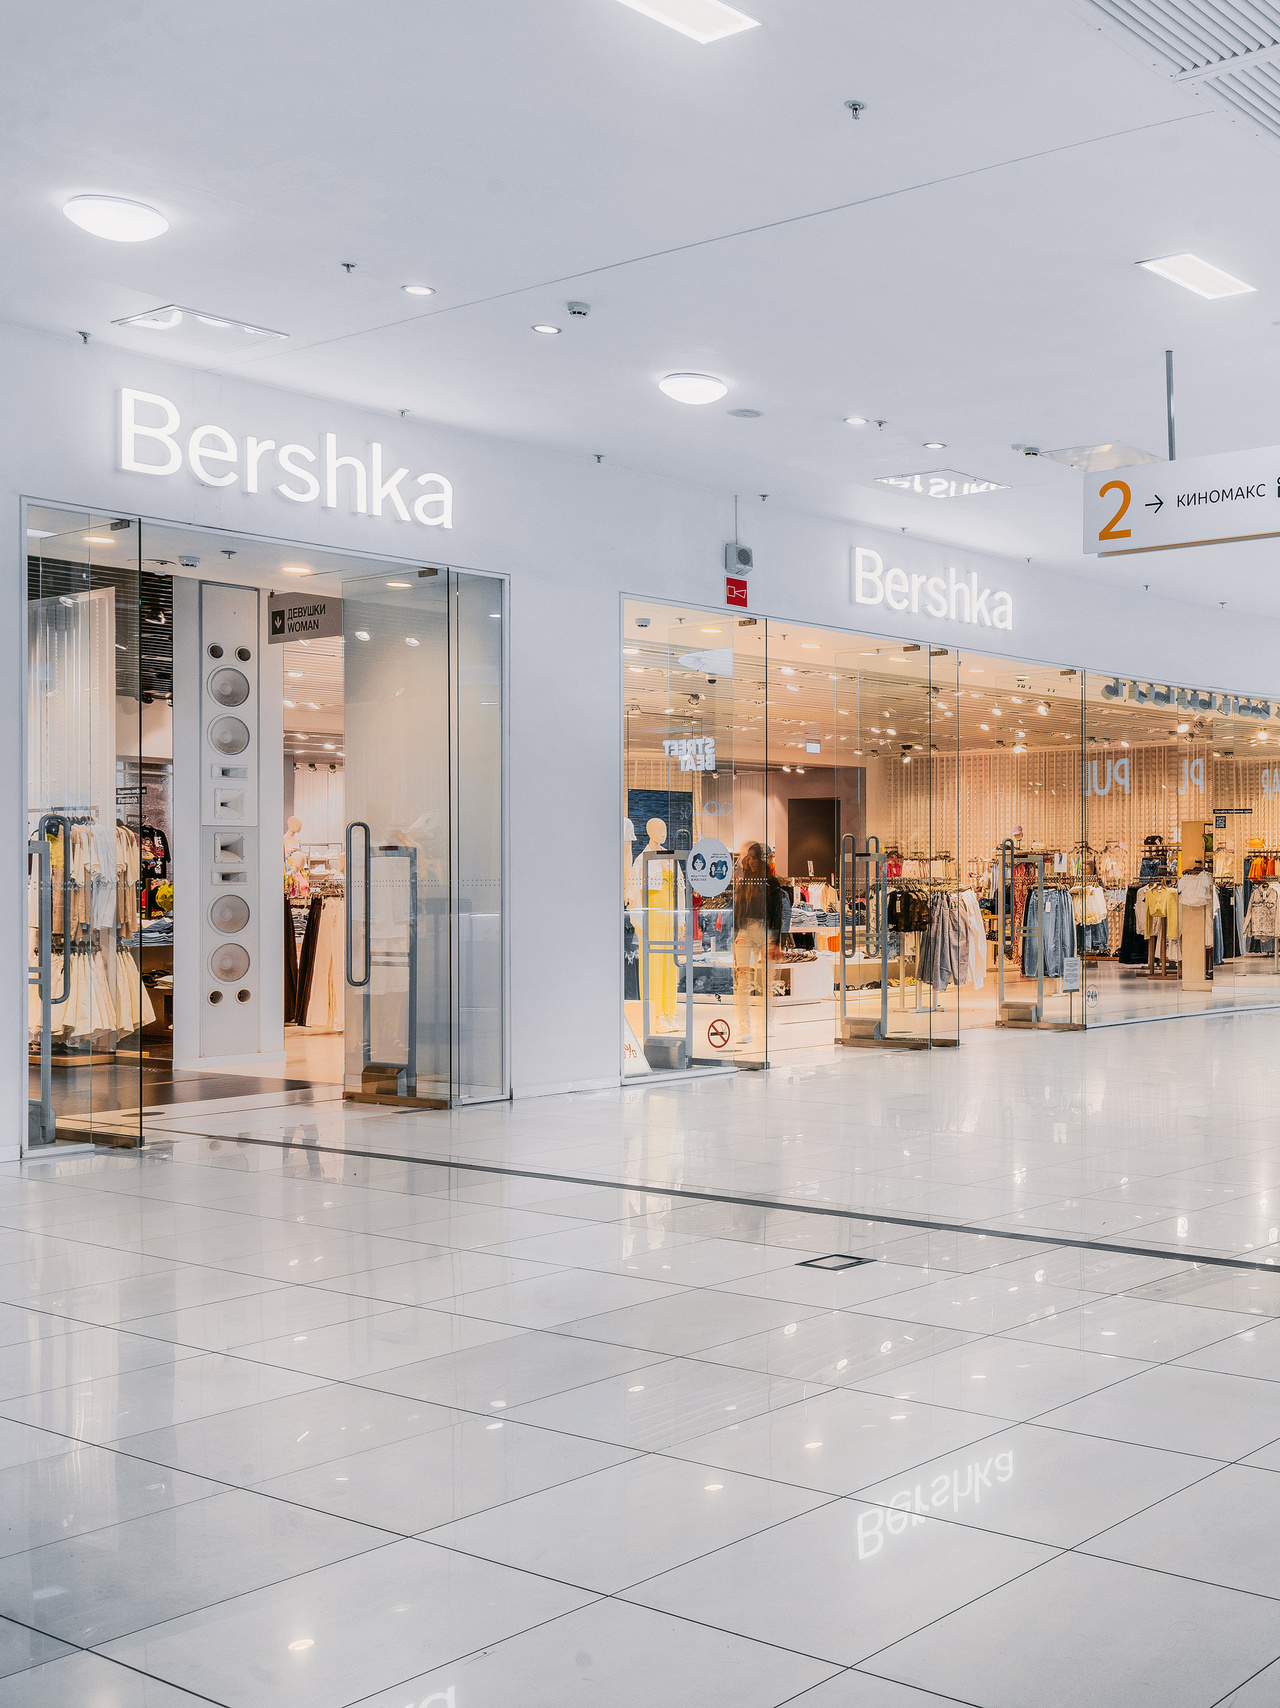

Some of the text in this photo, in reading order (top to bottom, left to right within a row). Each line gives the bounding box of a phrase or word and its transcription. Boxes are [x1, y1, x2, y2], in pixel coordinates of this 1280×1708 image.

[118, 386, 454, 530] Bershka
[1099, 480, 1132, 542] 2
[1176, 483, 1266, 508] КИНОМАКС
[287, 604, 326, 621] ДЕВУШКИ
[853, 546, 1013, 631] Bershka
[287, 619, 319, 633] WOMAN
